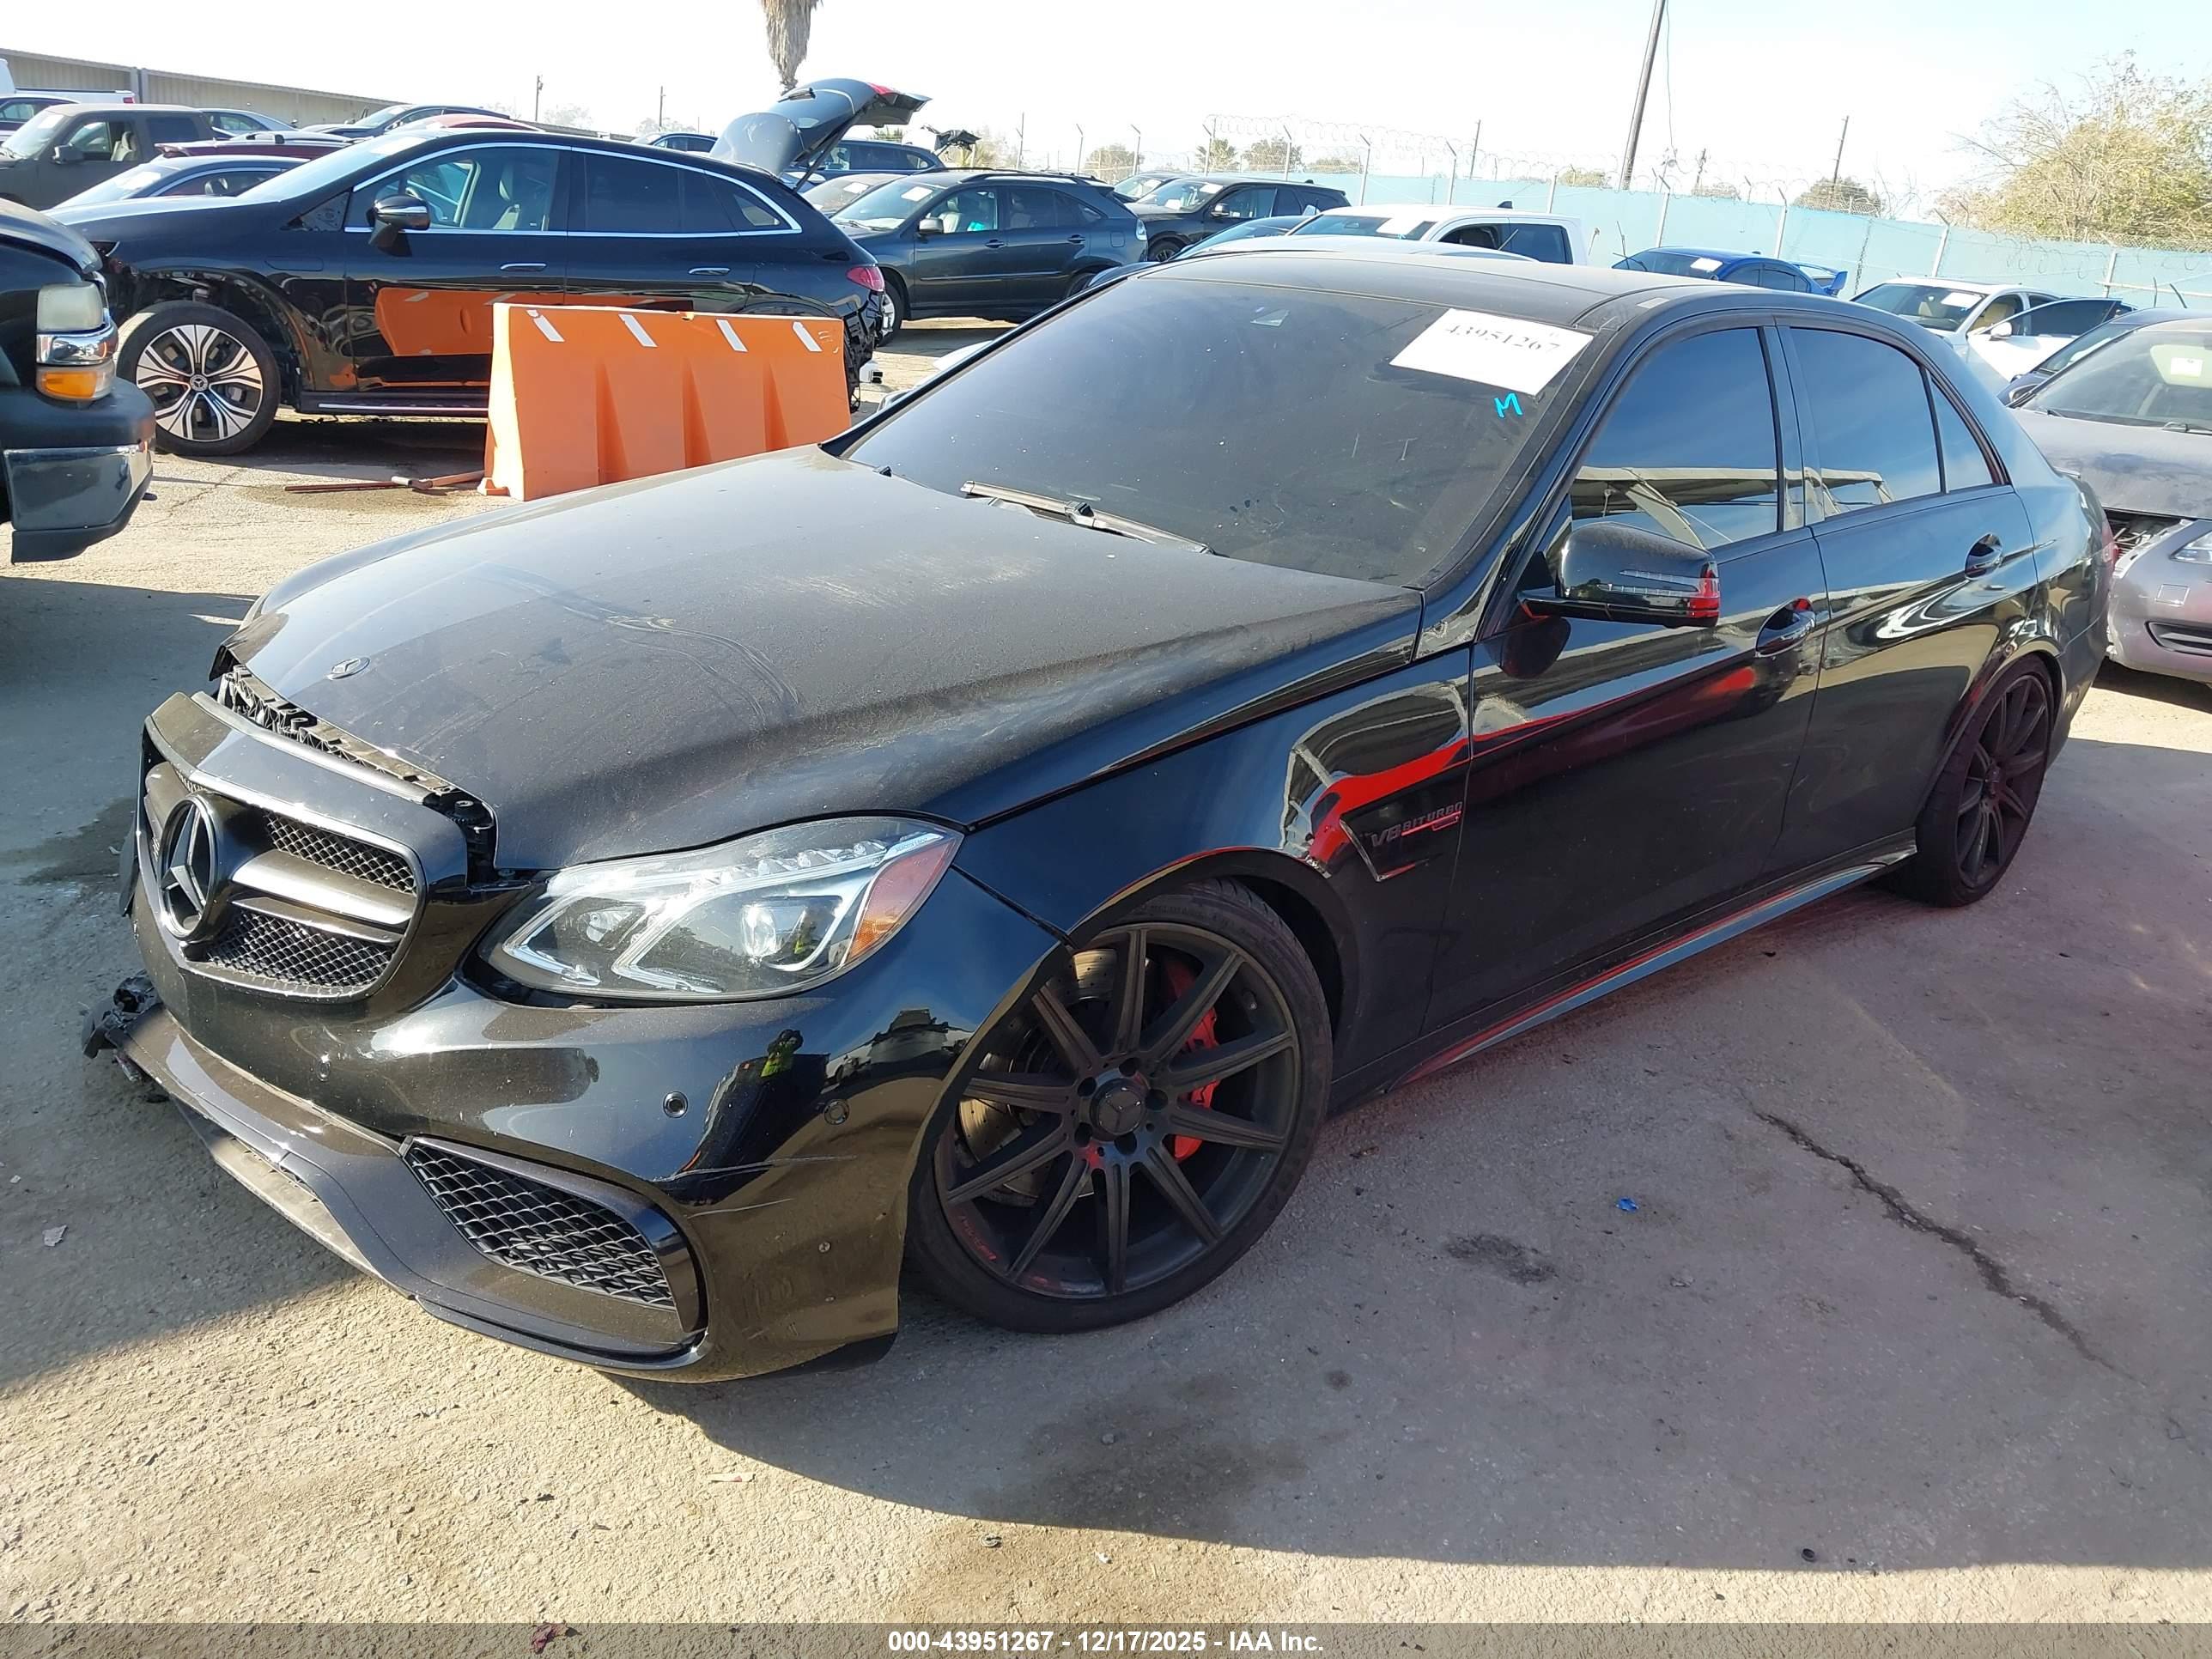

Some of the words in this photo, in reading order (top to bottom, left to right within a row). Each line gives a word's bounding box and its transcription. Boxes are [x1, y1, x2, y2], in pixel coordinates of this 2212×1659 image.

[1445, 324, 1561, 353] 43951267
[1493, 392, 1523, 418] M
[1370, 823, 1402, 847] V8
[1402, 801, 1463, 830] BITURBO
